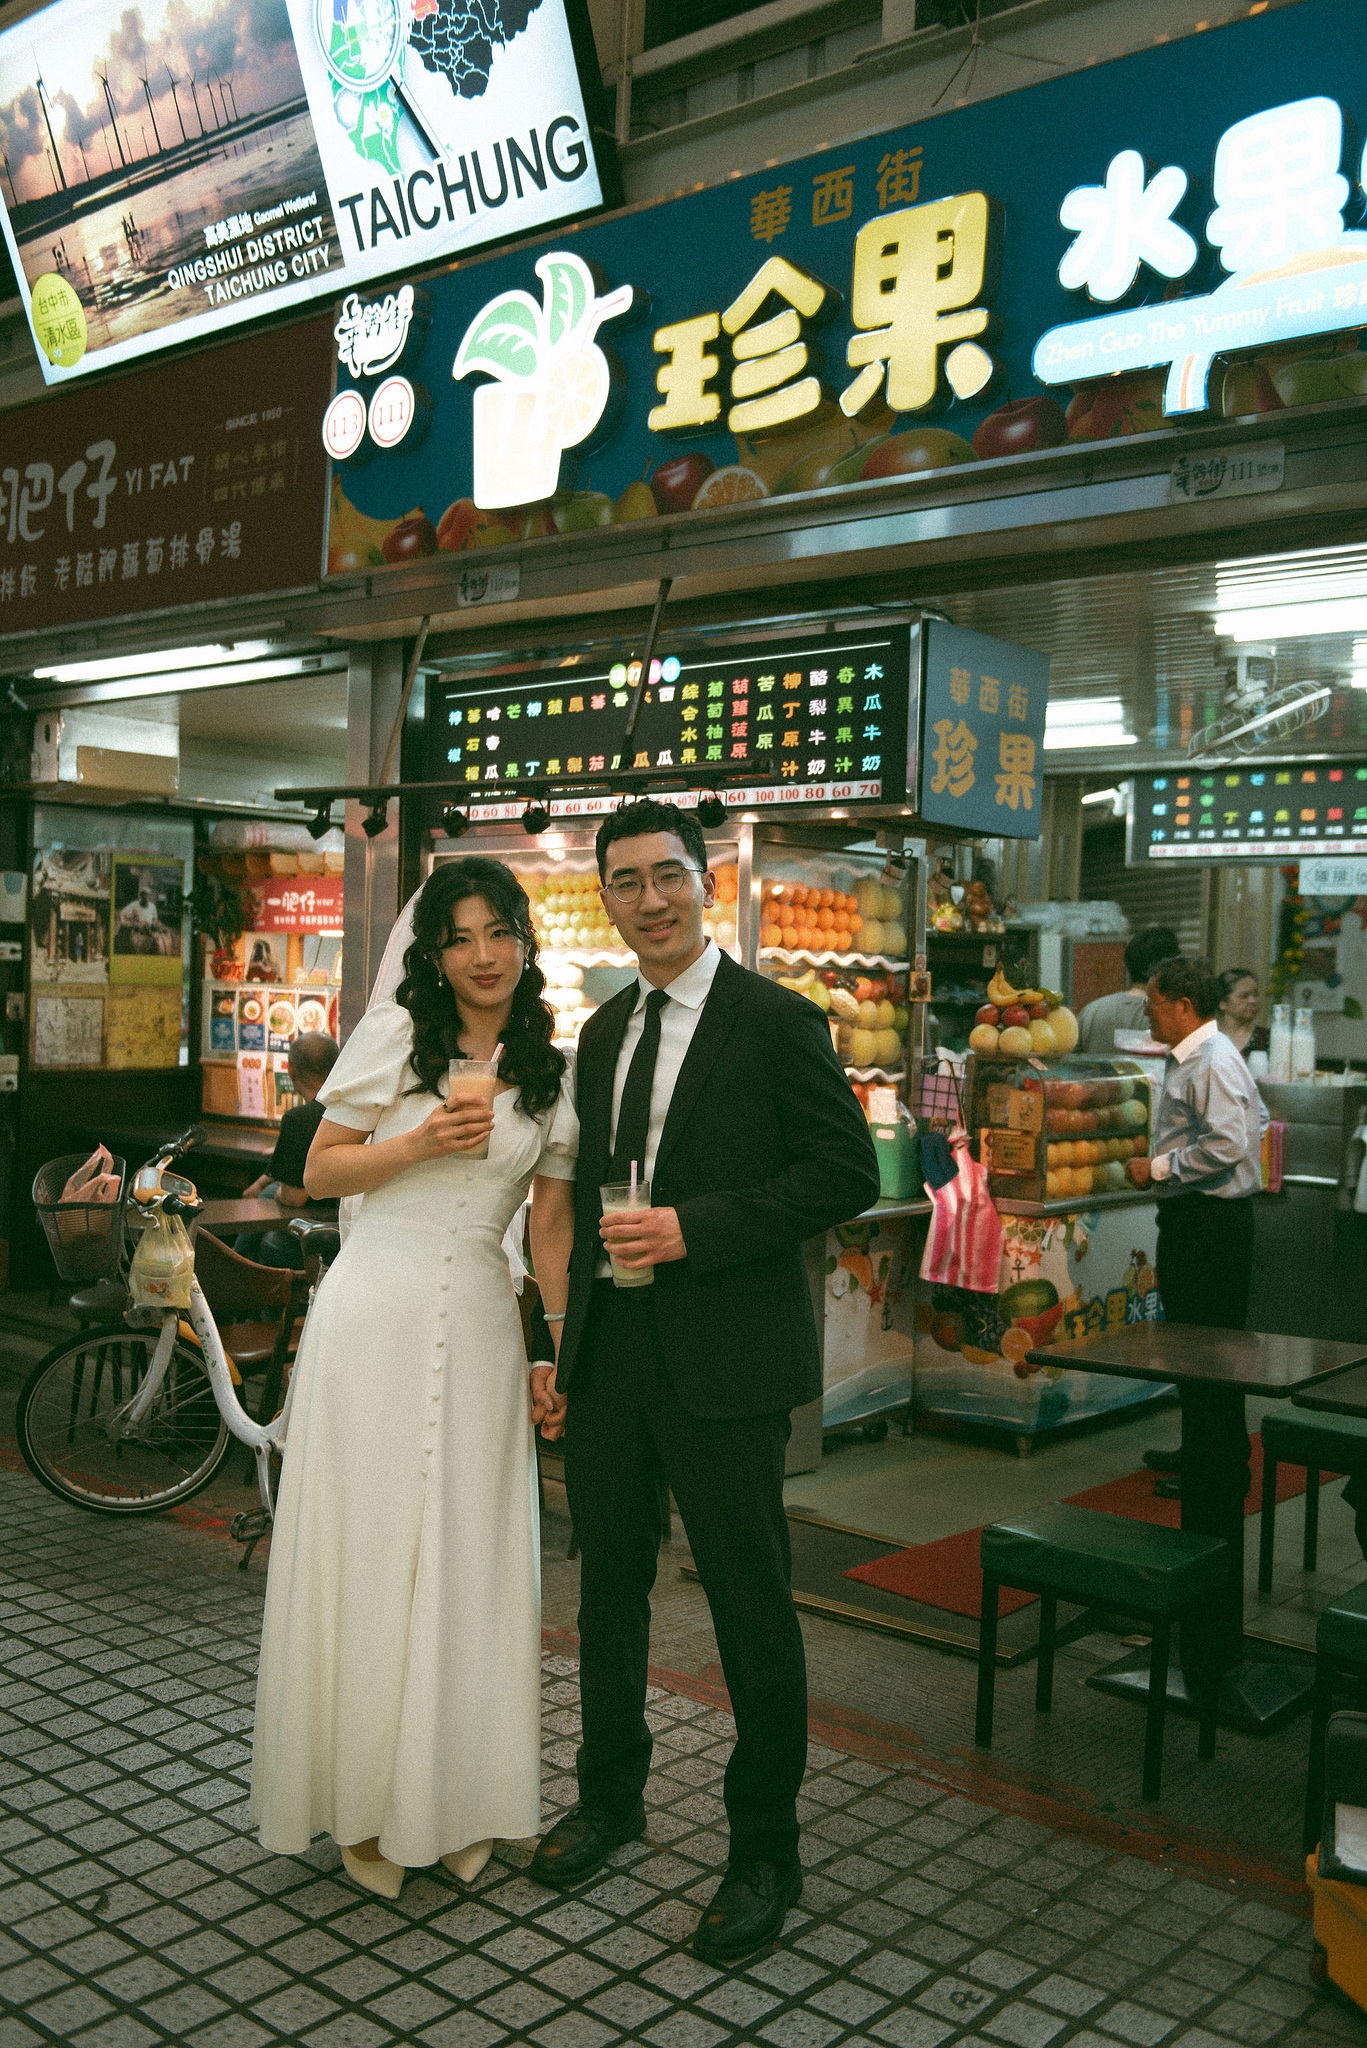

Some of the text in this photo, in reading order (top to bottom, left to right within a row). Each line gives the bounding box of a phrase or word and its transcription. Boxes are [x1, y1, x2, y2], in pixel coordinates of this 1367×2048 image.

[283, 190, 318, 216] Wetland
[338, 115, 588, 252] TAICHUNG
[750, 146, 923, 243] 華西街
[1058, 96, 1367, 303] 水果
[167, 215, 323, 290] QINGSHUI DISTRICT
[203, 244, 330, 306] TAICHUNG CITY
[38, 289, 70, 315] 台中市
[43, 317, 82, 349] 清水區
[648, 191, 993, 433] 珍果
[1045, 283, 1367, 365] Zhen Guo The Yummy Fruit 珍
[331, 413, 358, 438] 113
[377, 400, 405, 426] 111
[125, 467, 143, 495] YI
[150, 455, 195, 490] FAT
[1230, 461, 1253, 480] 111
[588, 693, 606, 772] 番茄
[656, 685, 676, 768] 西瓜
[680, 682, 700, 765] 綜合水果
[705, 680, 725, 761] 葡萄柚原
[756, 675, 775, 750] 苦瓜原
[780, 672, 802, 777] 柳丁原汁
[807, 669, 828, 776] 酪梨牛奶
[834, 666, 855, 774] 奇異果汁
[861, 662, 884, 772] 木瓜牛奶
[950, 666, 1029, 722] 華西街
[504, 703, 522, 778] 芒果
[525, 700, 543, 777] 柳丁
[546, 698, 563, 775] 蘋果
[567, 695, 585, 773] 鳳梨
[930, 718, 1036, 811] 珍果
[483, 806, 498, 819] 60
[504, 804, 517, 818] 80
[565, 801, 581, 814] 60
[586, 800, 602, 813] 60
[728, 791, 746, 803] 60
[755, 790, 775, 803] 100
[779, 788, 799, 801] 100
[805, 787, 825, 799] 80
[832, 785, 852, 798] 60
[859, 783, 880, 796] 70
[1072, 1290, 1164, 1338] 珍果水果
